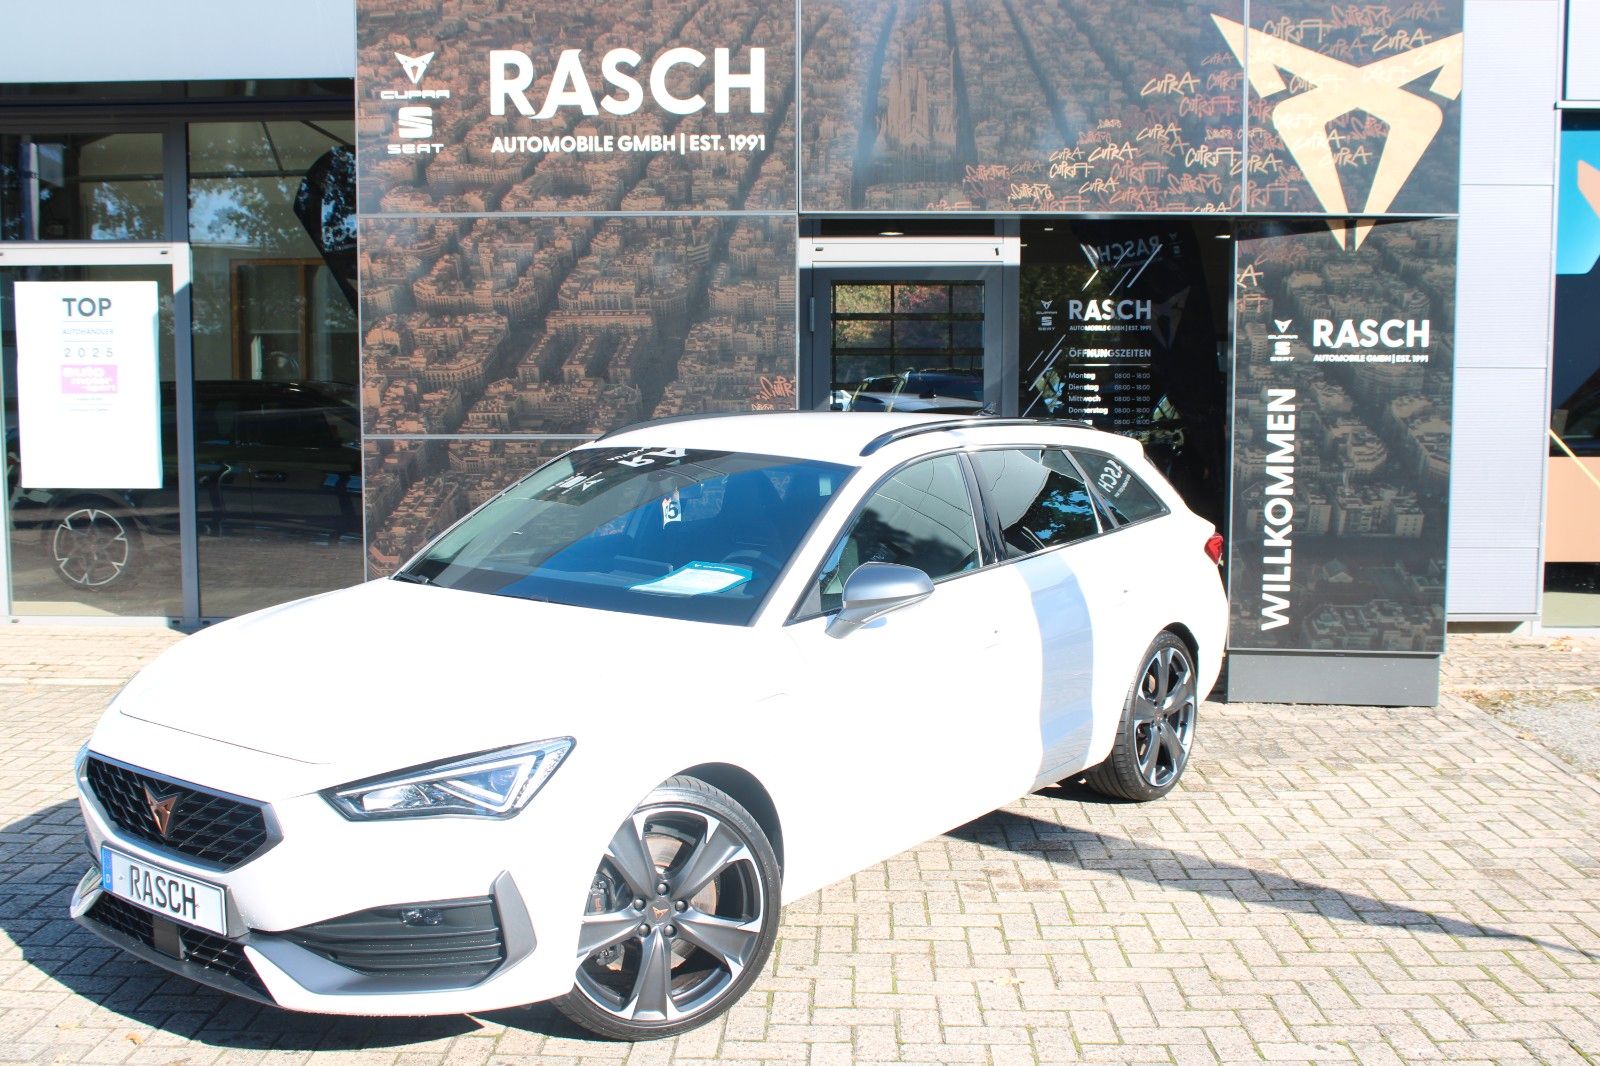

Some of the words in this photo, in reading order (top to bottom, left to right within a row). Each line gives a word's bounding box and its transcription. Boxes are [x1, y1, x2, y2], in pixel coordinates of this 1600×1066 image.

[1372, 28, 1432, 52] CUPRA
[489, 47, 766, 119] RASCH
[1140, 71, 1200, 97] CUPRA
[380, 89, 450, 99] CUPRA
[1136, 122, 1182, 143] CUPRA
[387, 143, 444, 154] SEAT
[490, 135, 614, 153] AUTOMOBILE
[617, 135, 676, 151] GMBH
[689, 134, 725, 151] EST.
[727, 134, 766, 152] 1991
[1088, 141, 1138, 162] CUPRA
[1050, 147, 1085, 162] CUPRA
[1078, 177, 1119, 195] CUPRA
[62, 297, 112, 317] TOP
[1069, 299, 1152, 321] RASCH
[1313, 318, 1430, 349] RASCH
[1068, 347, 1152, 358] ÖFFNUNGSZEITEN
[1068, 372, 1096, 381] Montag
[1068, 383, 1099, 392] Dienstag
[1068, 406, 1109, 415] Donnerstag
[1261, 388, 1296, 631] WILLKOMMEN
[129, 864, 197, 920] RASCH
